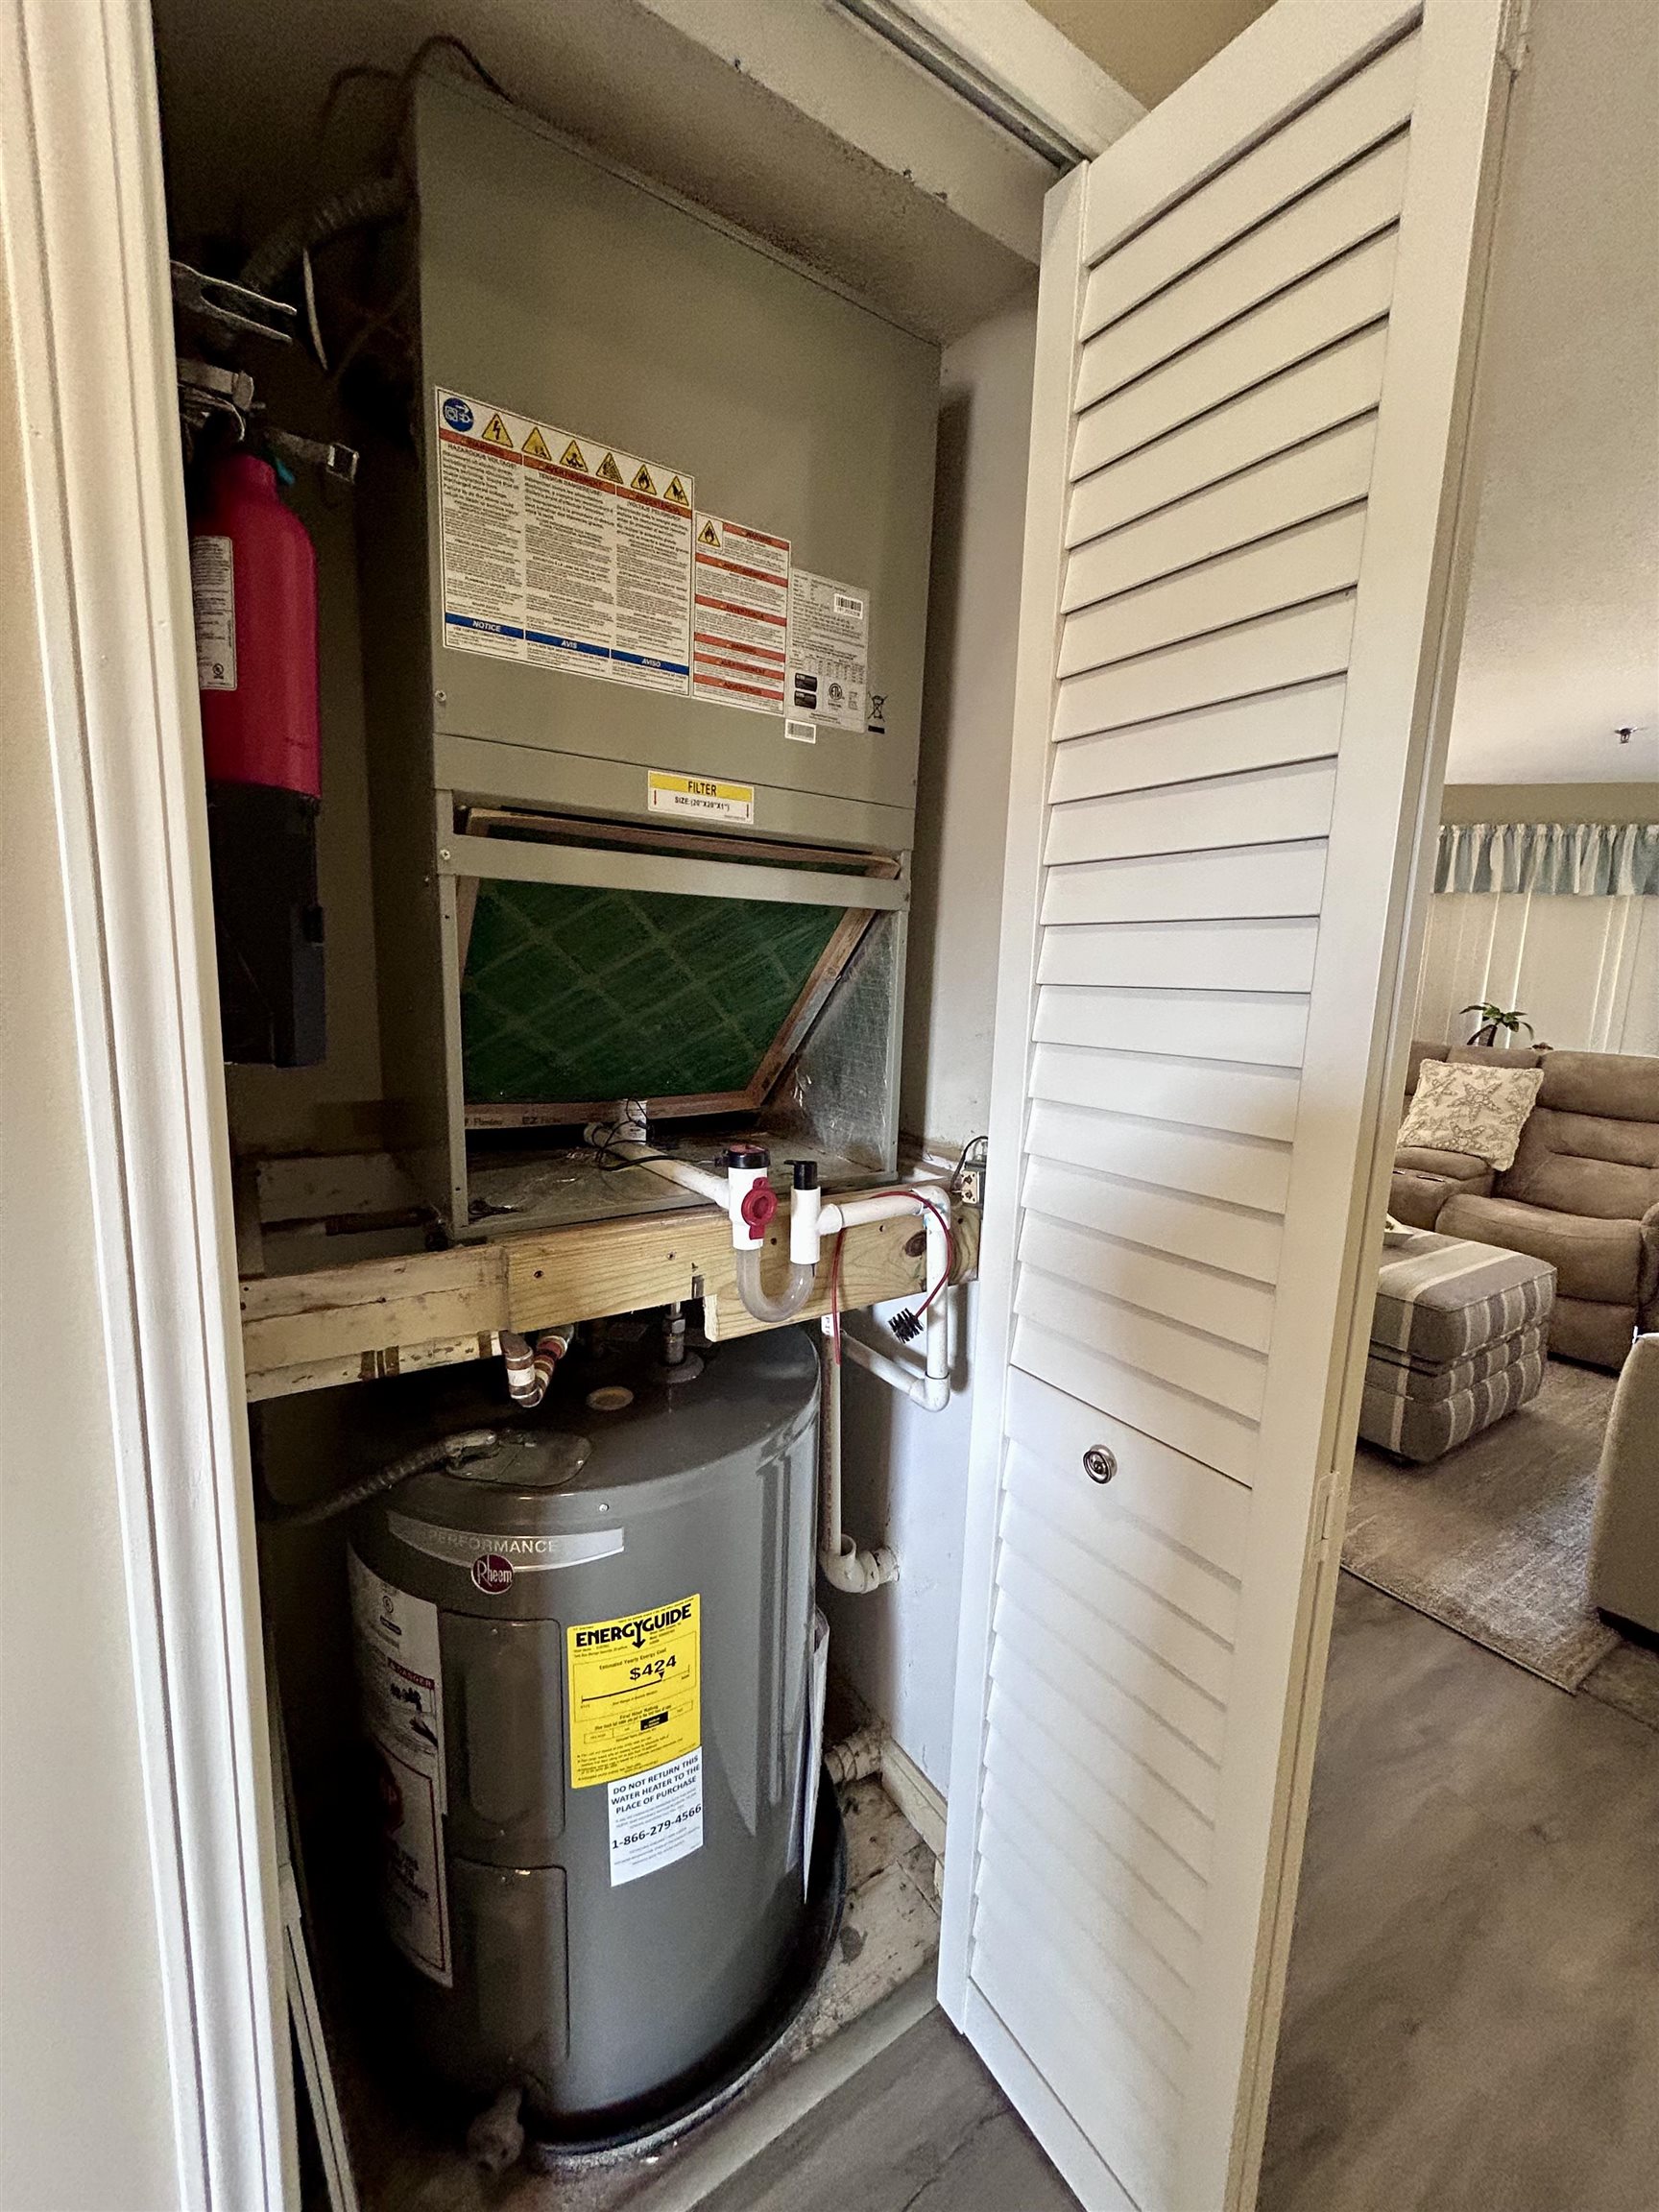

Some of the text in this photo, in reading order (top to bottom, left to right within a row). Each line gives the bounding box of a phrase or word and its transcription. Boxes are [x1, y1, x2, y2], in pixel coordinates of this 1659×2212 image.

[472, 620, 501, 632] NOTICE
[561, 639, 578, 649] AVIS
[641, 658, 661, 667] AVISO
[687, 781, 717, 797] FILTER
[428, 1530, 558, 1553] PERFORMANCE
[476, 1554, 513, 1587] Rheem
[576, 1603, 692, 1648] ENERGYGUIDE
[629, 1655, 677, 1681] $424
[611, 1764, 700, 1805] WATER HEATER TO THE
[613, 1755, 698, 1794] DO NOT RETURN THIS
[615, 1776, 697, 1814] PLACE OF PURCHASE
[612, 1803, 702, 1849] 1-866-279-4566
